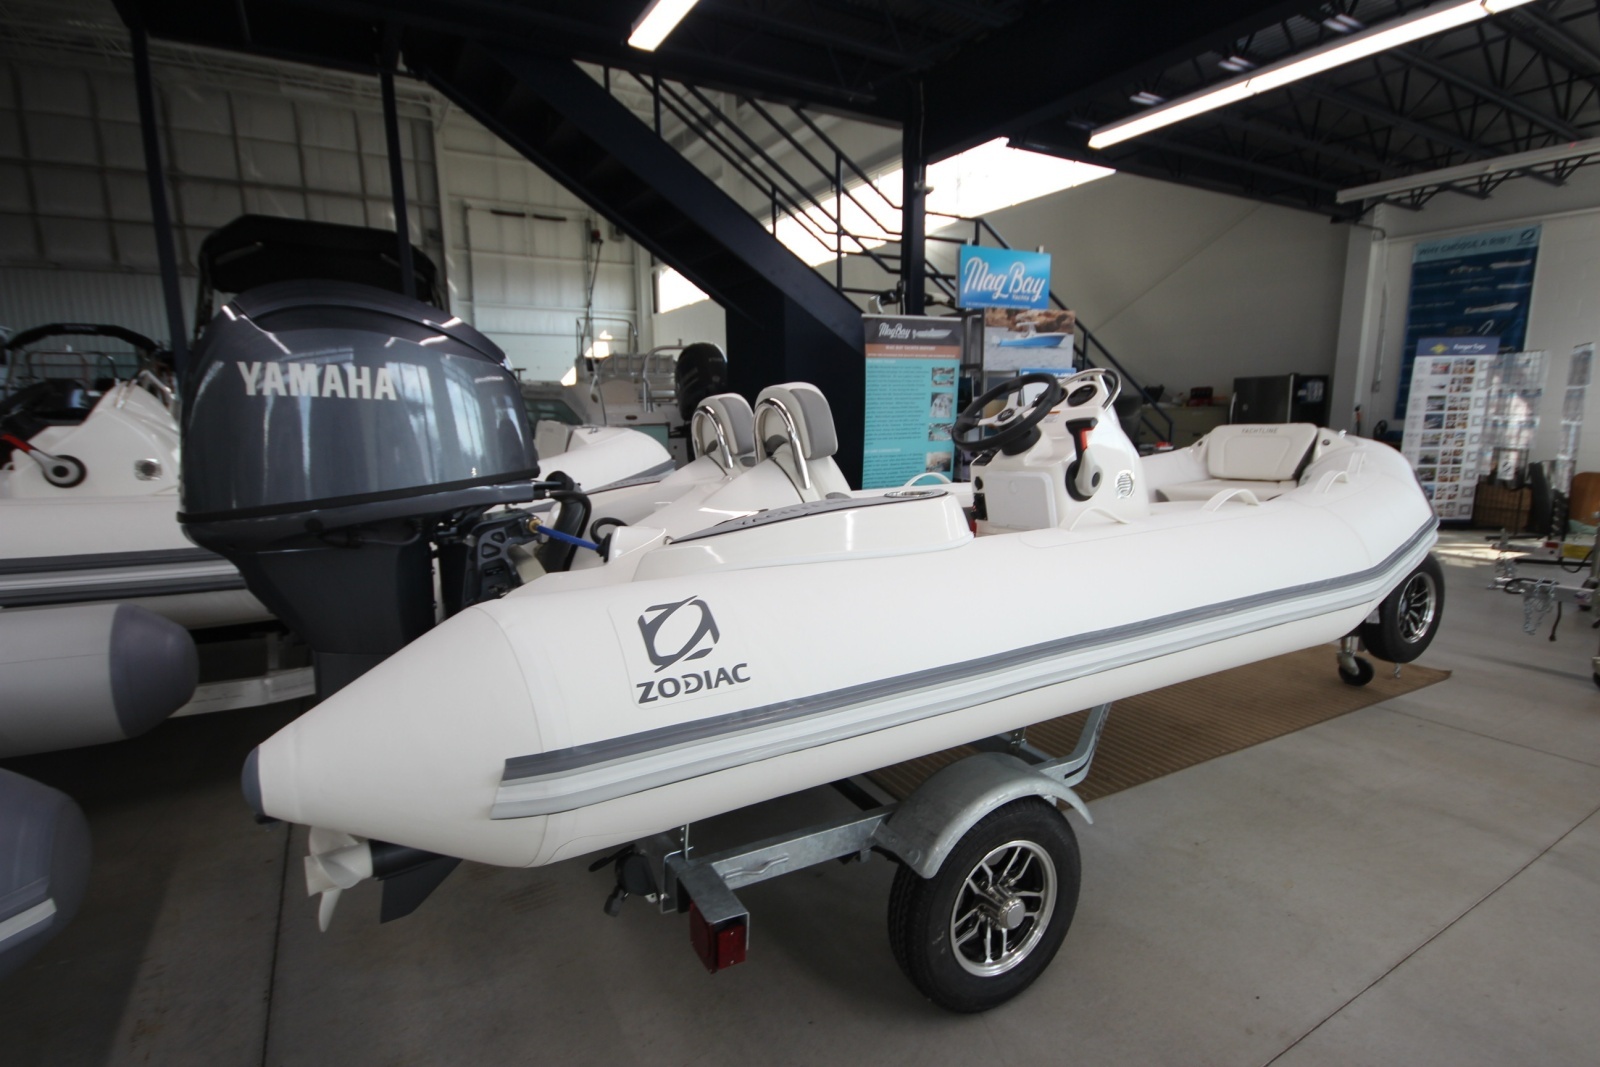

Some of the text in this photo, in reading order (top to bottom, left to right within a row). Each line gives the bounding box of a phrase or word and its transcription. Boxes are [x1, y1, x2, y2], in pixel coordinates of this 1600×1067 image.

[1441, 240, 1478, 252] CHOOSE
[964, 256, 1046, 303] Mag Bay
[237, 361, 397, 400] YAMAHA
[636, 663, 751, 704] ZODIAC
